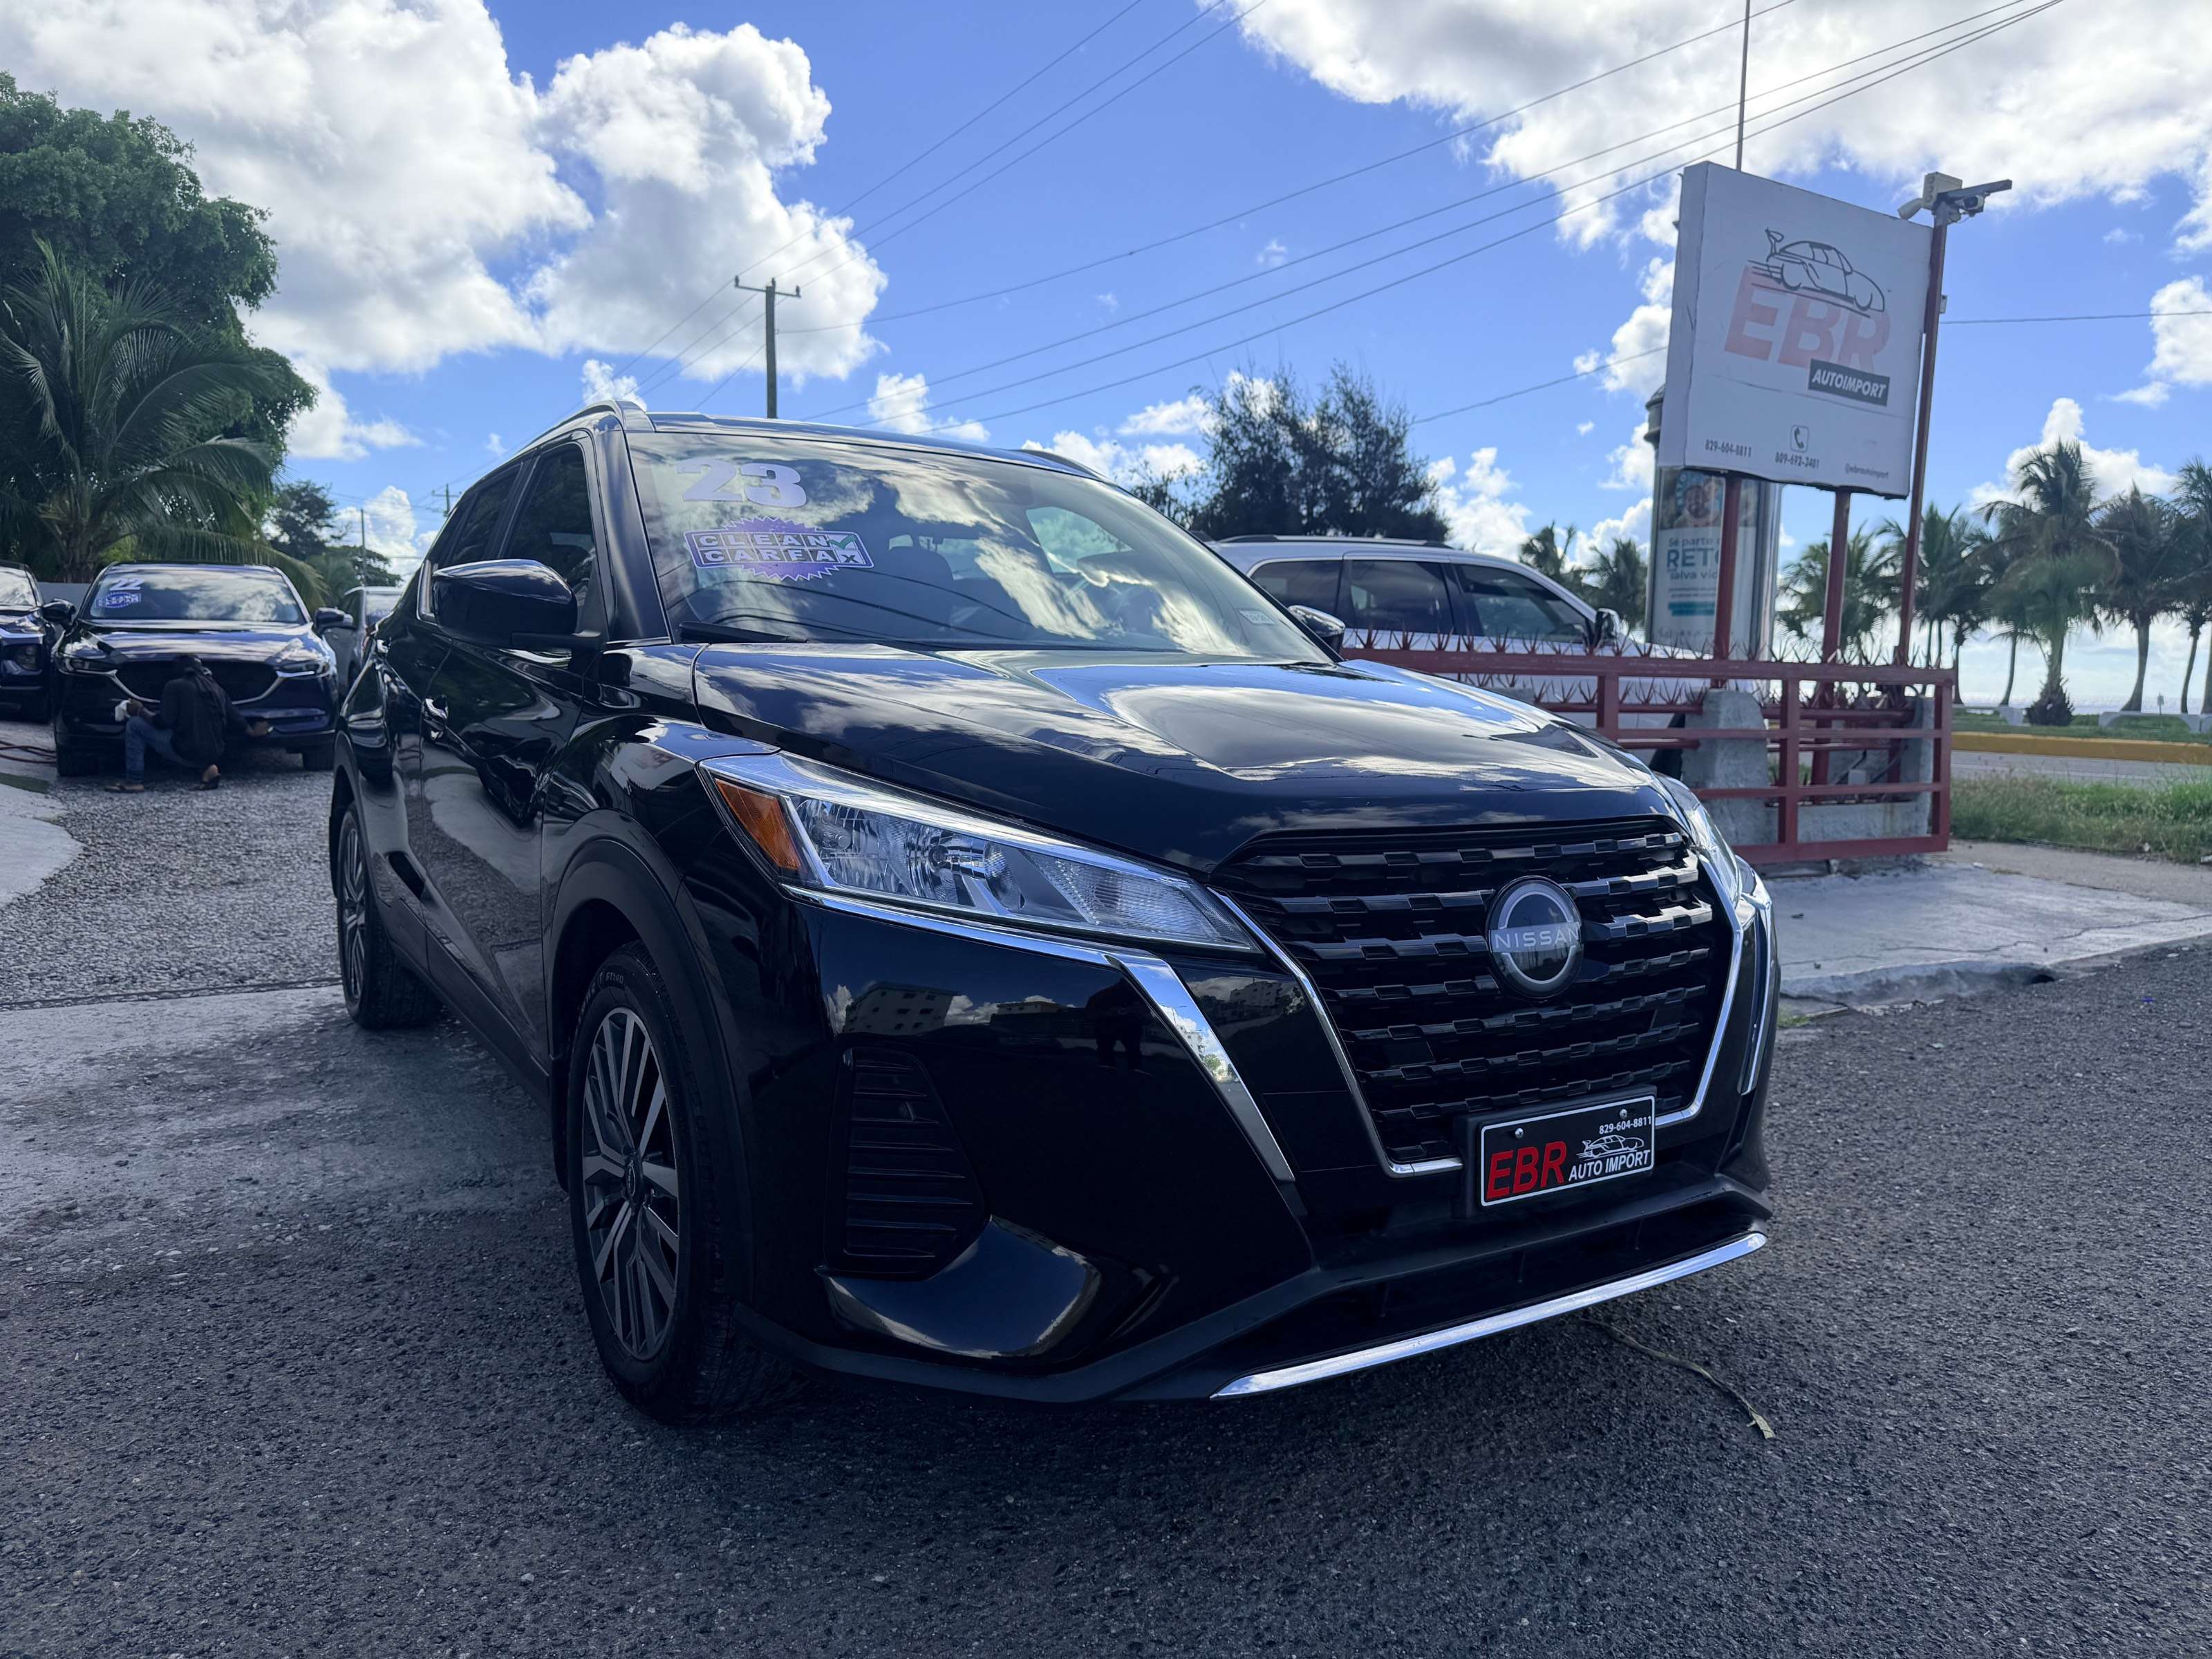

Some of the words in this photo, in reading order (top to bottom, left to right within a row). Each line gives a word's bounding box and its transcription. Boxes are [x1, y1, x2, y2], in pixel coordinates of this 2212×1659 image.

[1724, 265, 1891, 374] EBR
[1811, 368, 1887, 400] AUTOIMPORT
[1704, 438, 1752, 459] 829-604-8811
[676, 456, 807, 508] 23
[698, 534, 829, 549] CLEAN
[704, 548, 861, 565] CARFAX
[109, 578, 144, 591] 22
[1495, 927, 1580, 949] NISSAN
[1599, 1115, 1651, 1135] 829-604-8811
[1486, 1141, 1567, 1199] EBR
[1568, 1161, 1602, 1182] AUTO
[1604, 1150, 1651, 1174] IMPORT
